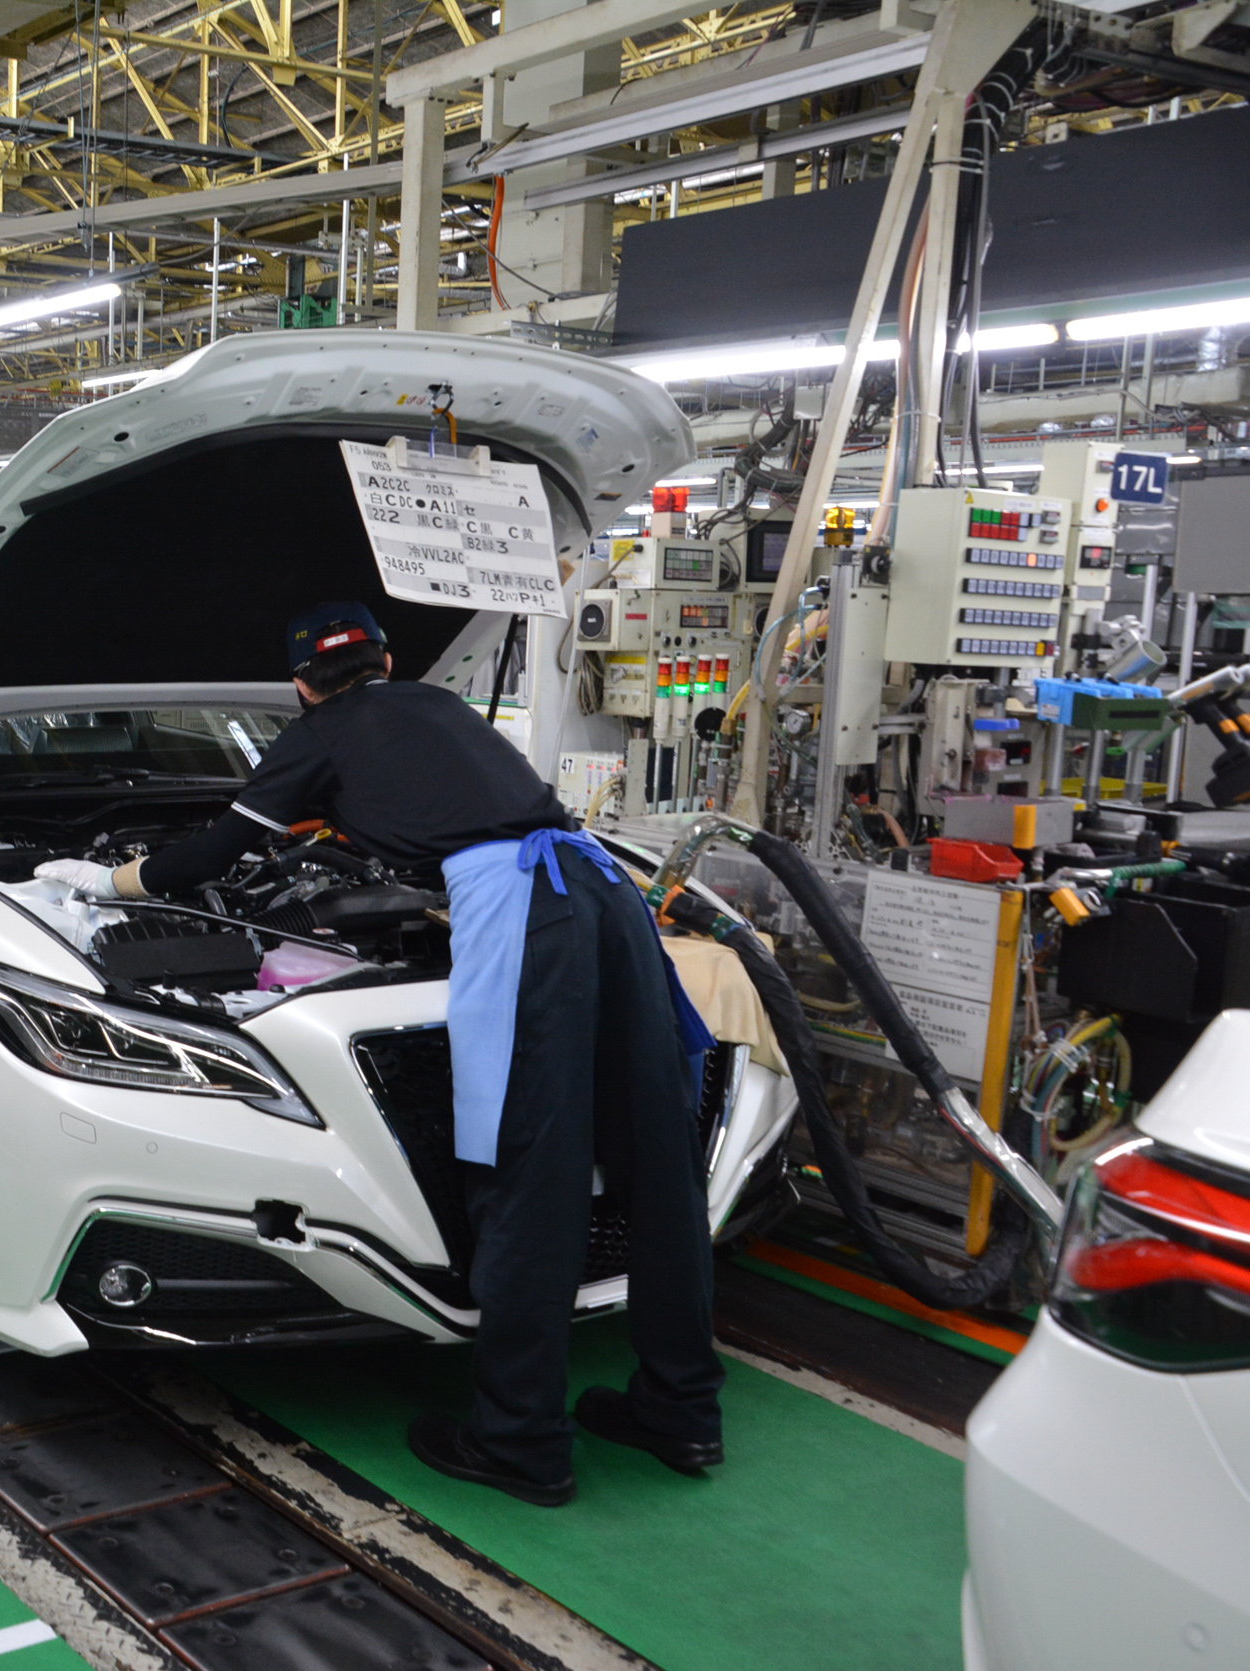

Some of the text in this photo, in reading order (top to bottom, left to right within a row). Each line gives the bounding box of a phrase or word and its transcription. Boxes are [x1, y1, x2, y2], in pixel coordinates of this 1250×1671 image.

[371, 460, 392, 472] 053
[1117, 463, 1163, 495] 17L
[368, 476, 410, 492] A2C2C
[518, 495, 530, 508] A
[384, 555, 425, 576] 948495
[561, 757, 574, 774] 47
